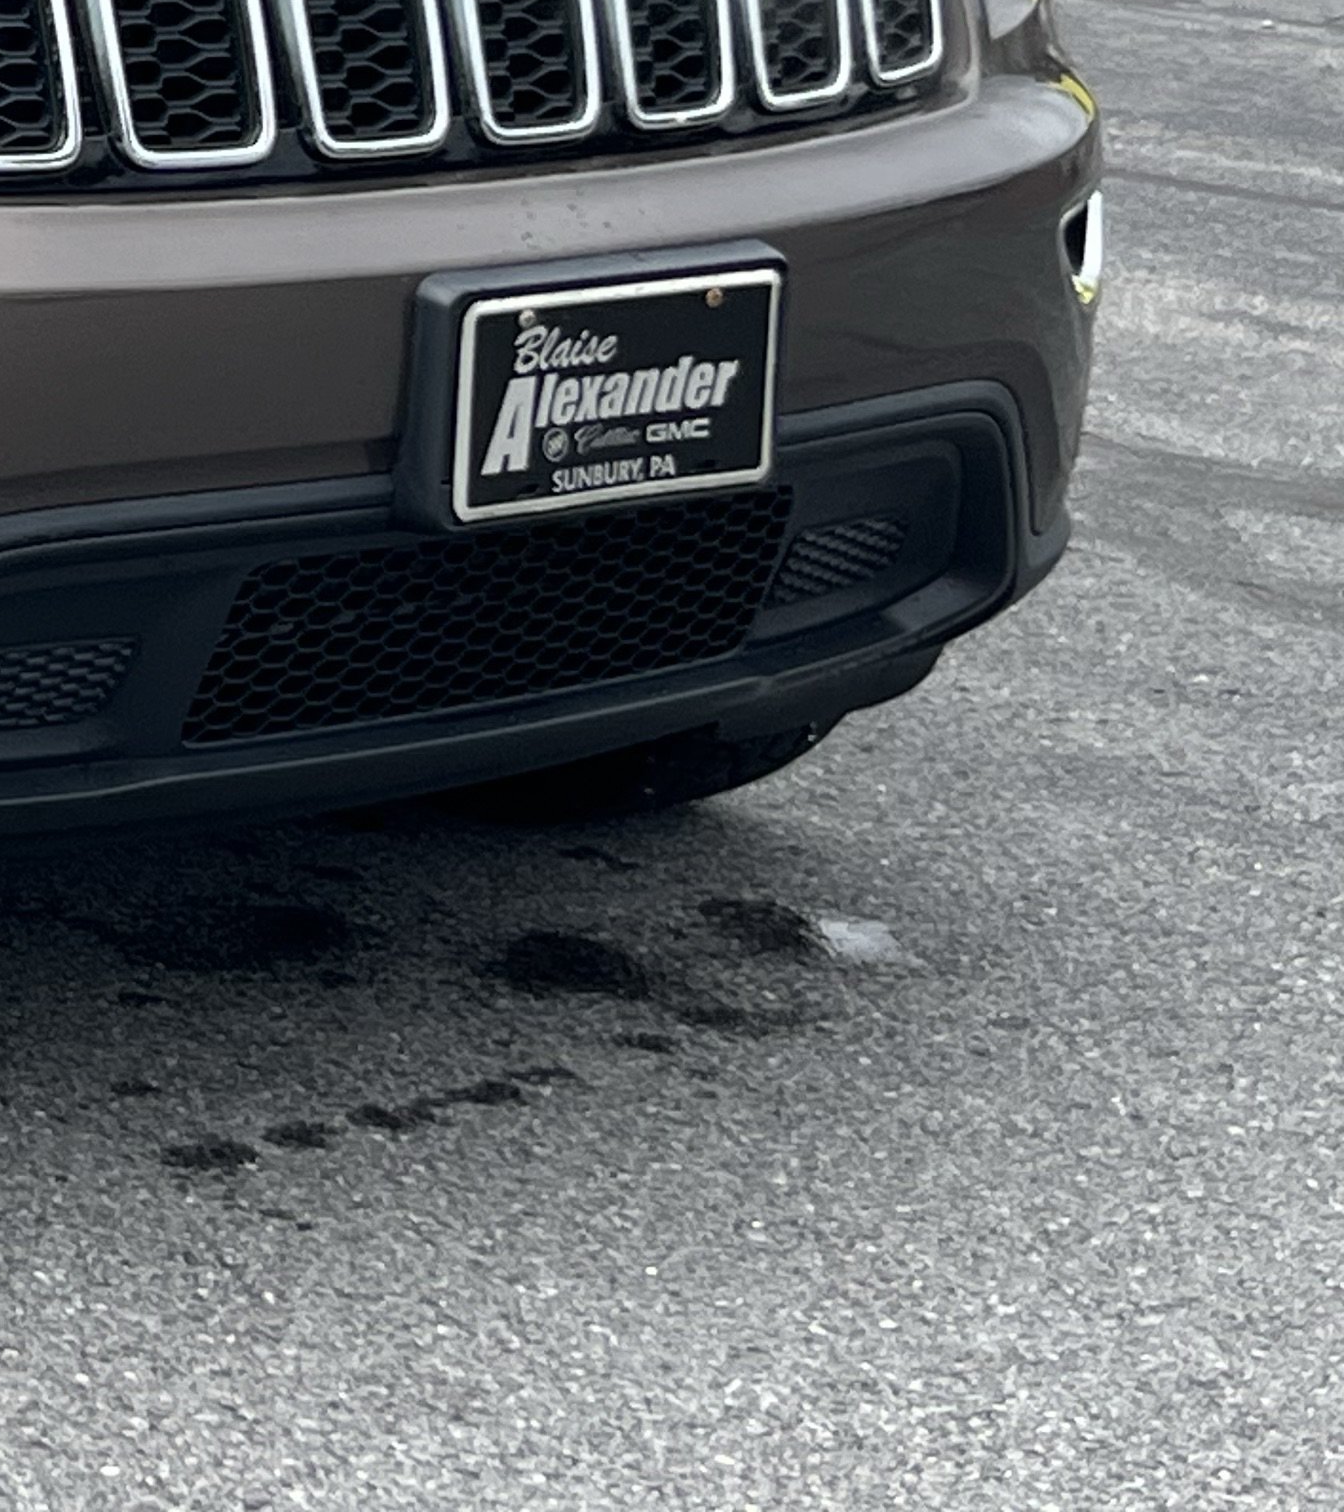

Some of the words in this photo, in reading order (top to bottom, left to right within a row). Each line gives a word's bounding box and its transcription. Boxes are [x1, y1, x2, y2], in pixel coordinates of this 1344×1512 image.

[513, 325, 619, 375] Blaise
[480, 355, 740, 477] Alexander
[645, 417, 711, 444] GMC
[649, 453, 676, 478] PA
